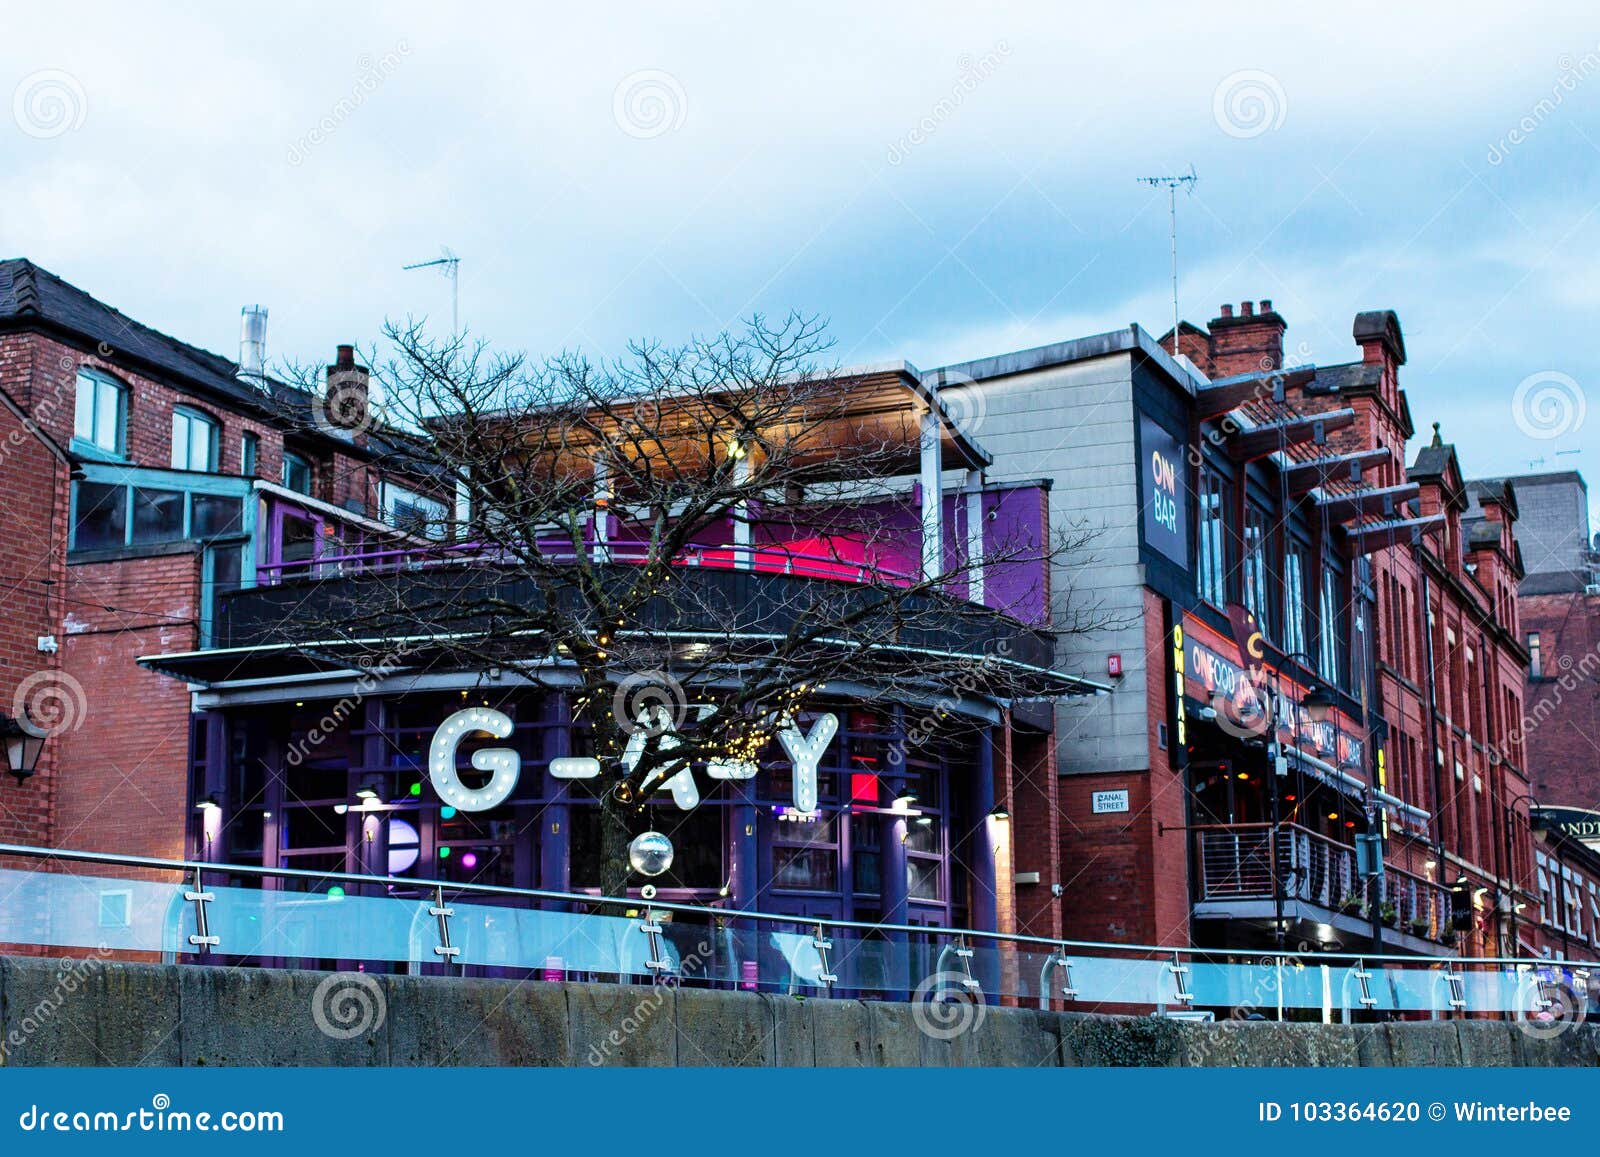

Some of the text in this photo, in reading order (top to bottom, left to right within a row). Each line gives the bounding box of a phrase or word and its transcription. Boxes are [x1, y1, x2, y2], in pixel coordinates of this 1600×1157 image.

[1154, 487, 1177, 534] BAR
[1098, 793, 1124, 802] CANAL
[1098, 802, 1125, 811] STREET
